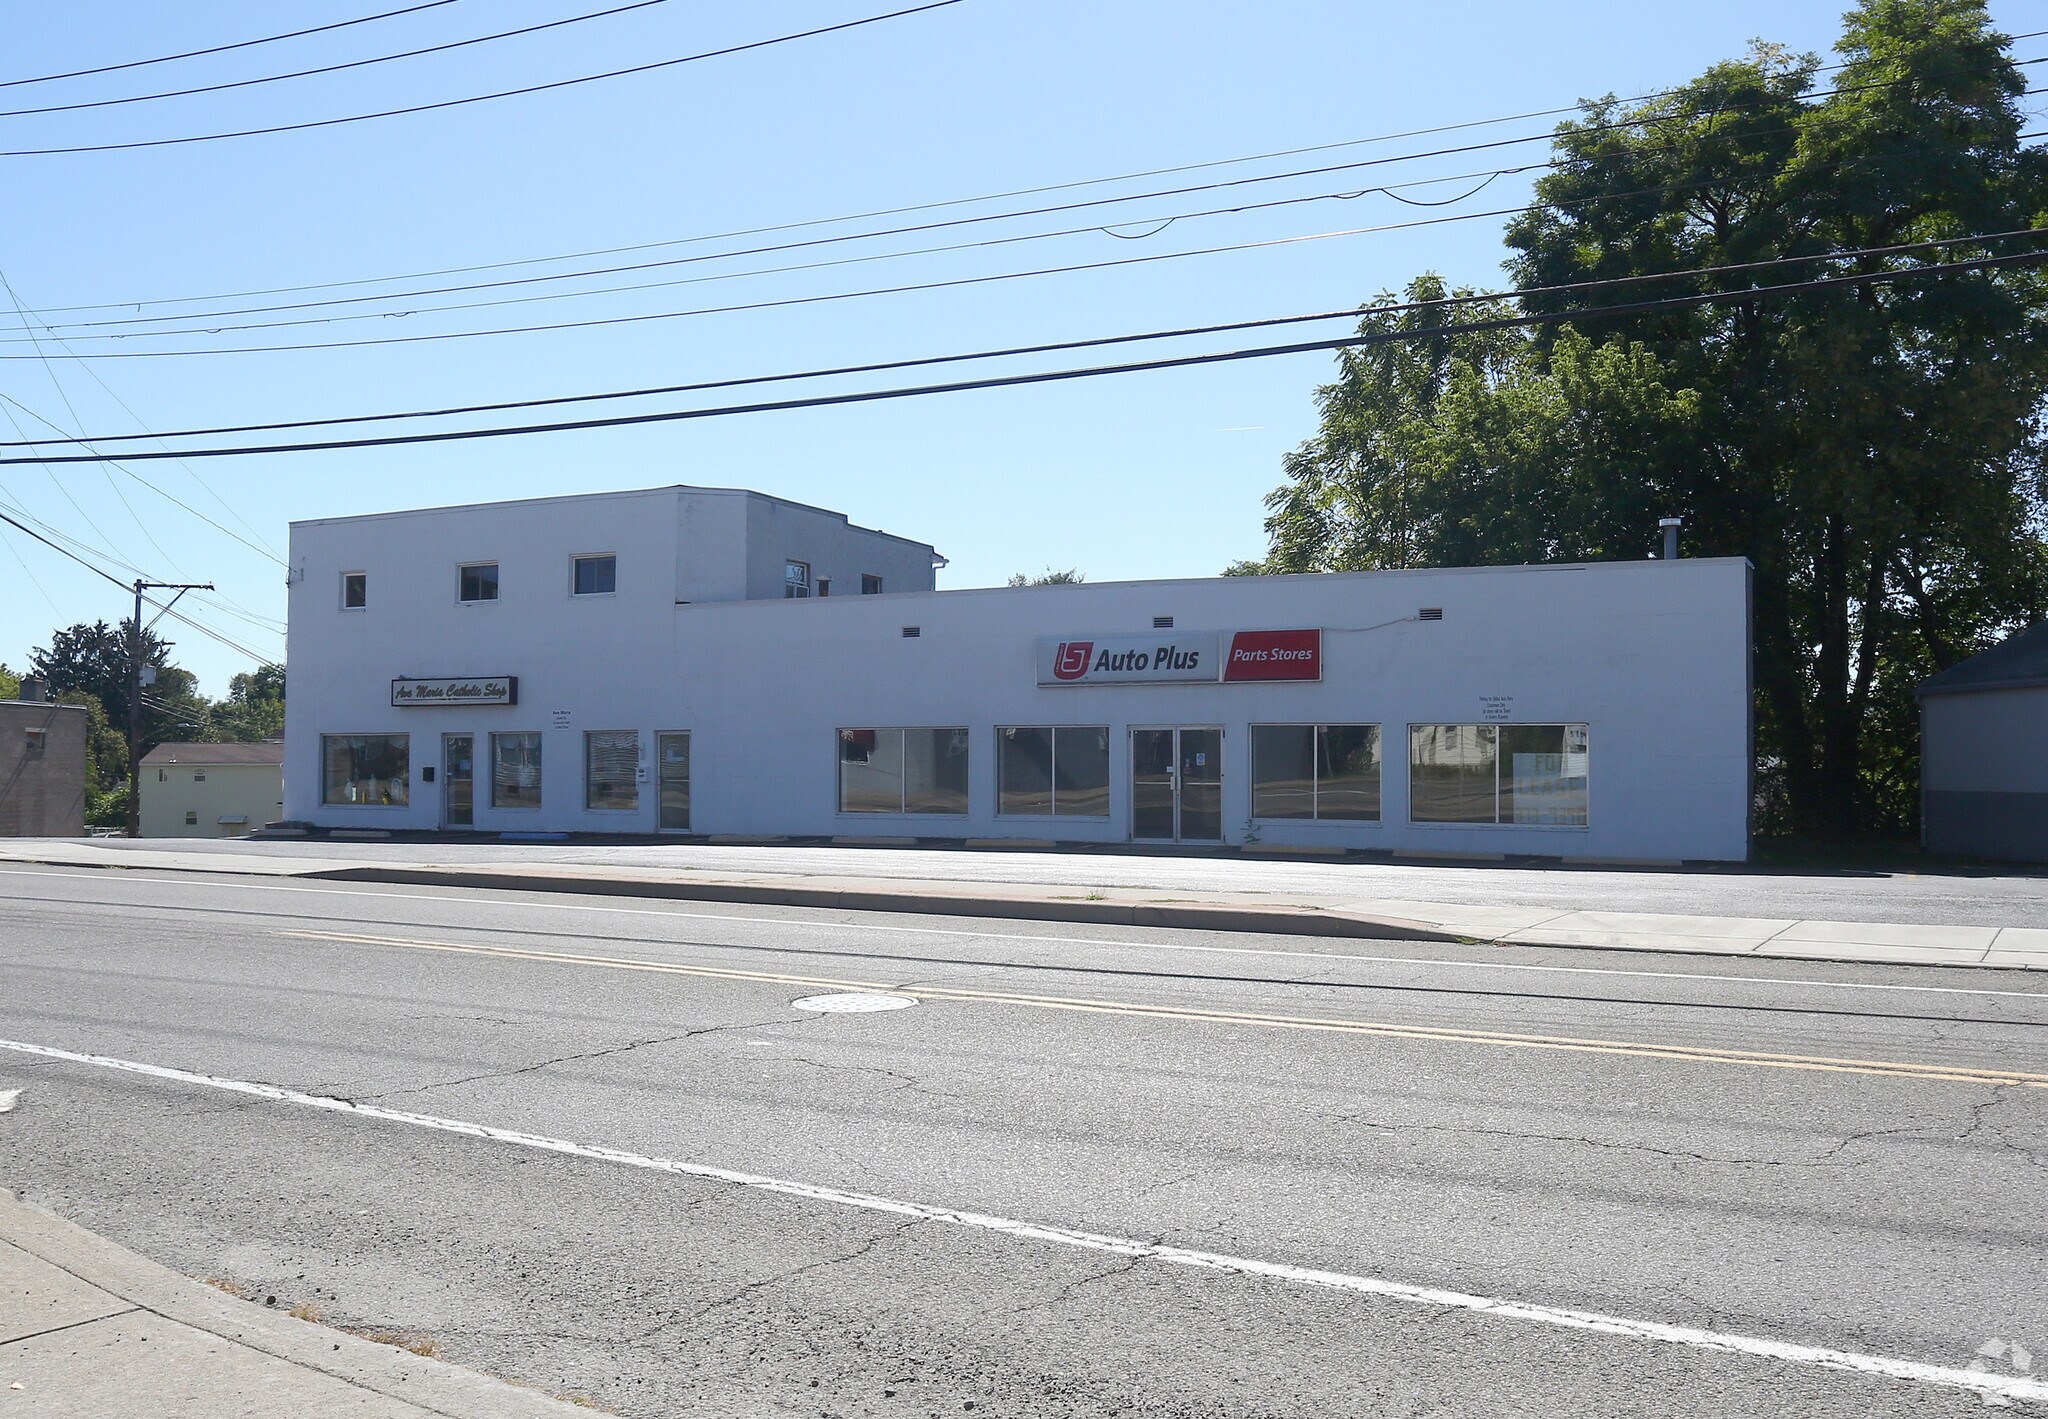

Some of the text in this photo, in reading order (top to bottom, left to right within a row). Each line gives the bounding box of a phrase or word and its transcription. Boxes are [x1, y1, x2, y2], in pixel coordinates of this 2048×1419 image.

[1094, 648, 1149, 672] Auto
[1153, 646, 1199, 671] Plus
[1233, 648, 1313, 662] Parts Stores
[416, 684, 445, 698] Maria
[446, 683, 482, 697] Catholic
[483, 682, 508, 699] Shop
